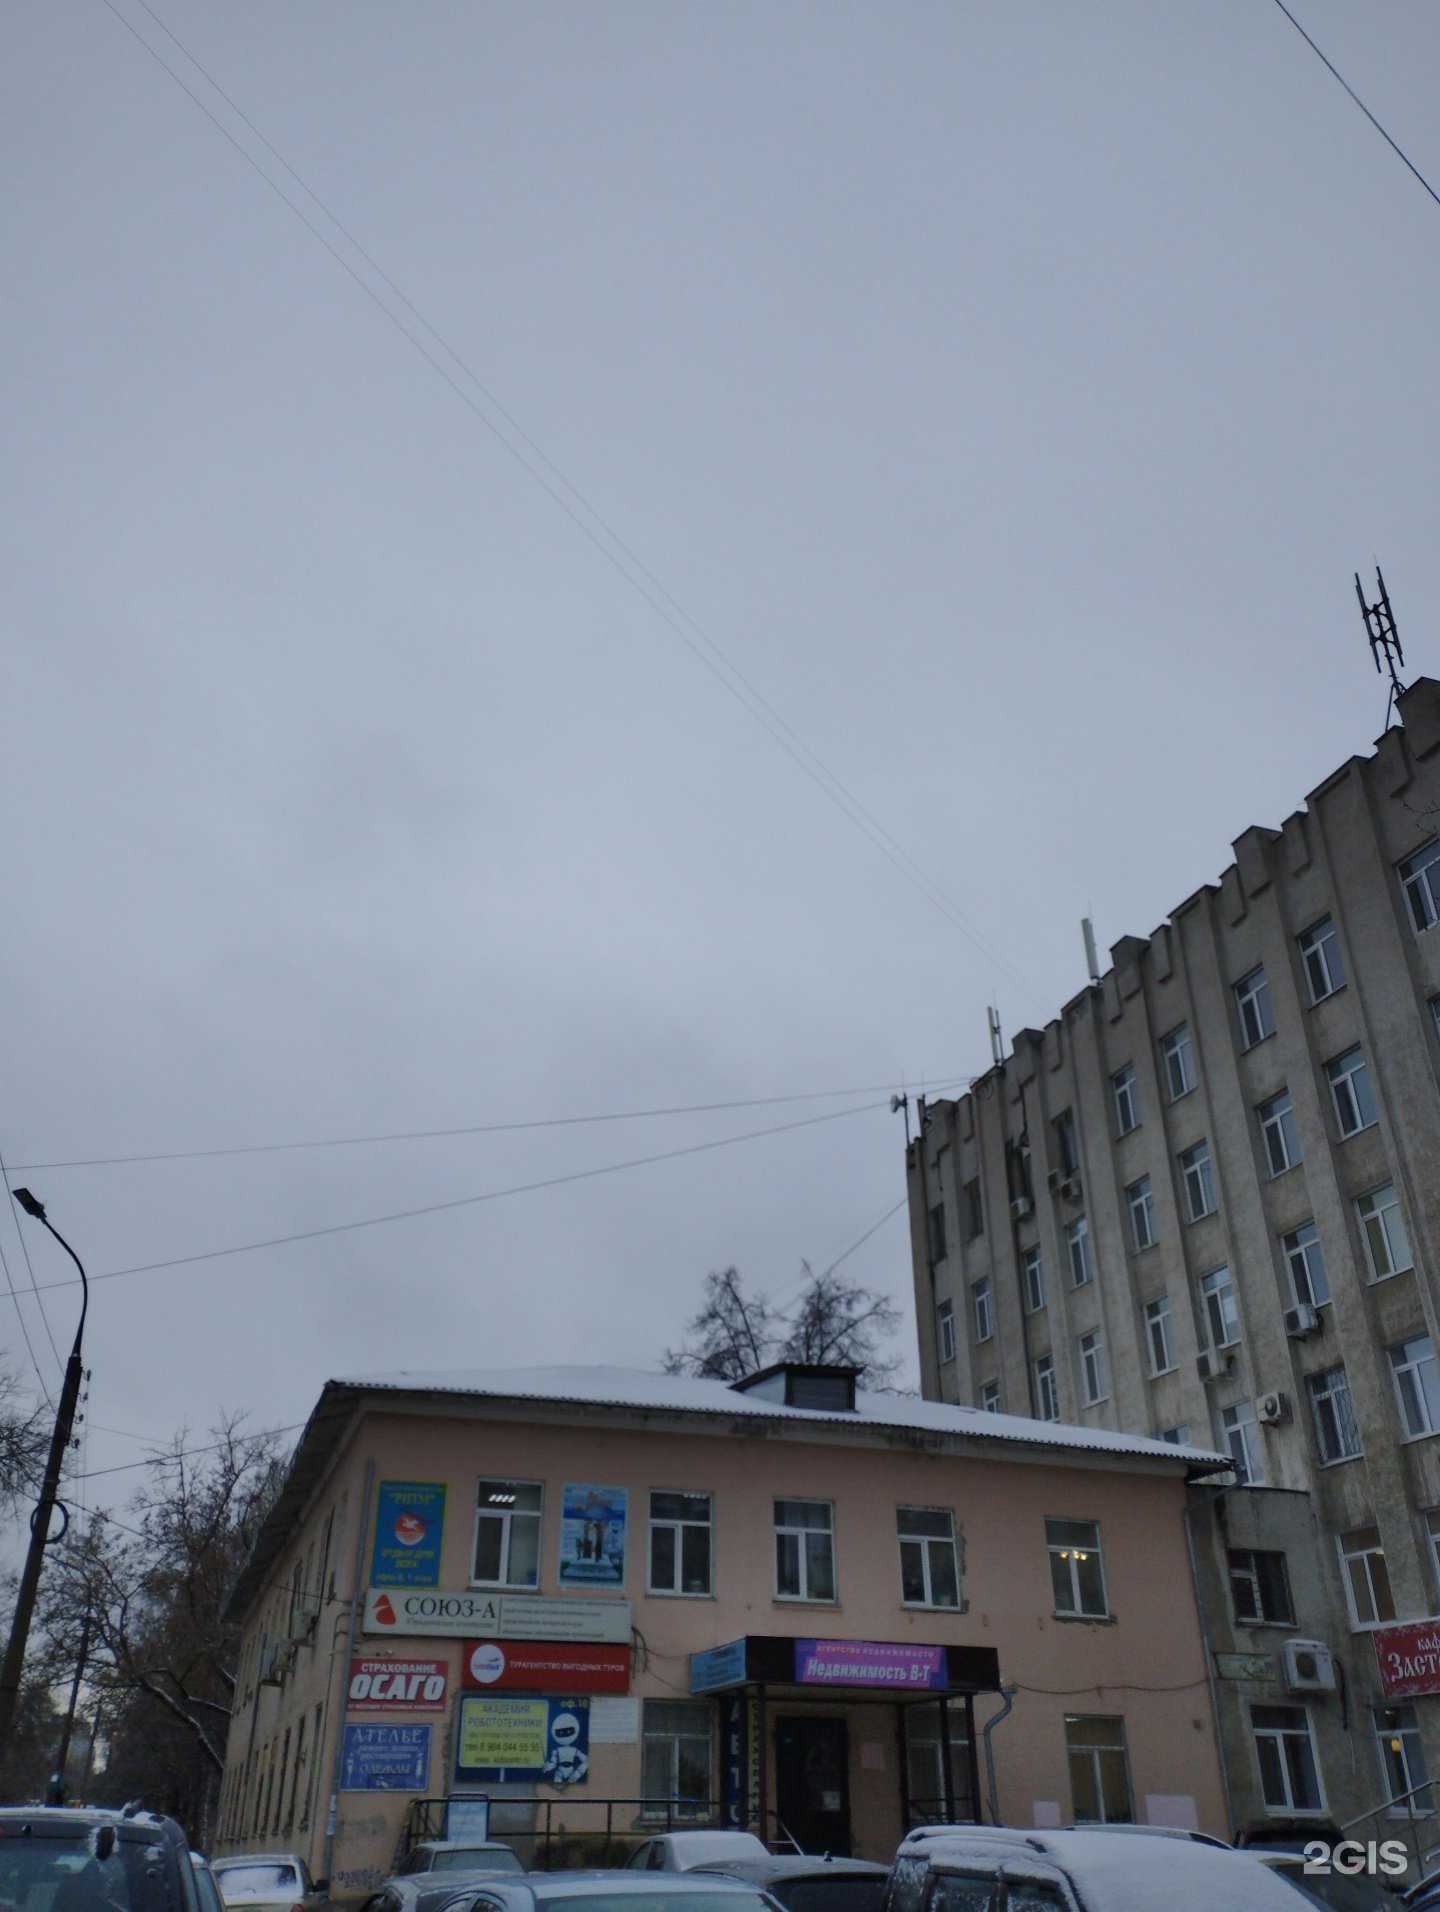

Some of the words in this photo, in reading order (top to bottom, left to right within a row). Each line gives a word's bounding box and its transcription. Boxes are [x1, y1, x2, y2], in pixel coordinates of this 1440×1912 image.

[405, 1597, 496, 1619] СОЮЗ-А
[361, 1663, 437, 1673] СТРАХОВАНИЕ
[807, 1658, 906, 1680] Недвижимость
[349, 1673, 446, 1701] ОСАГО
[352, 1727, 424, 1744] АТЕЛЬЕ
